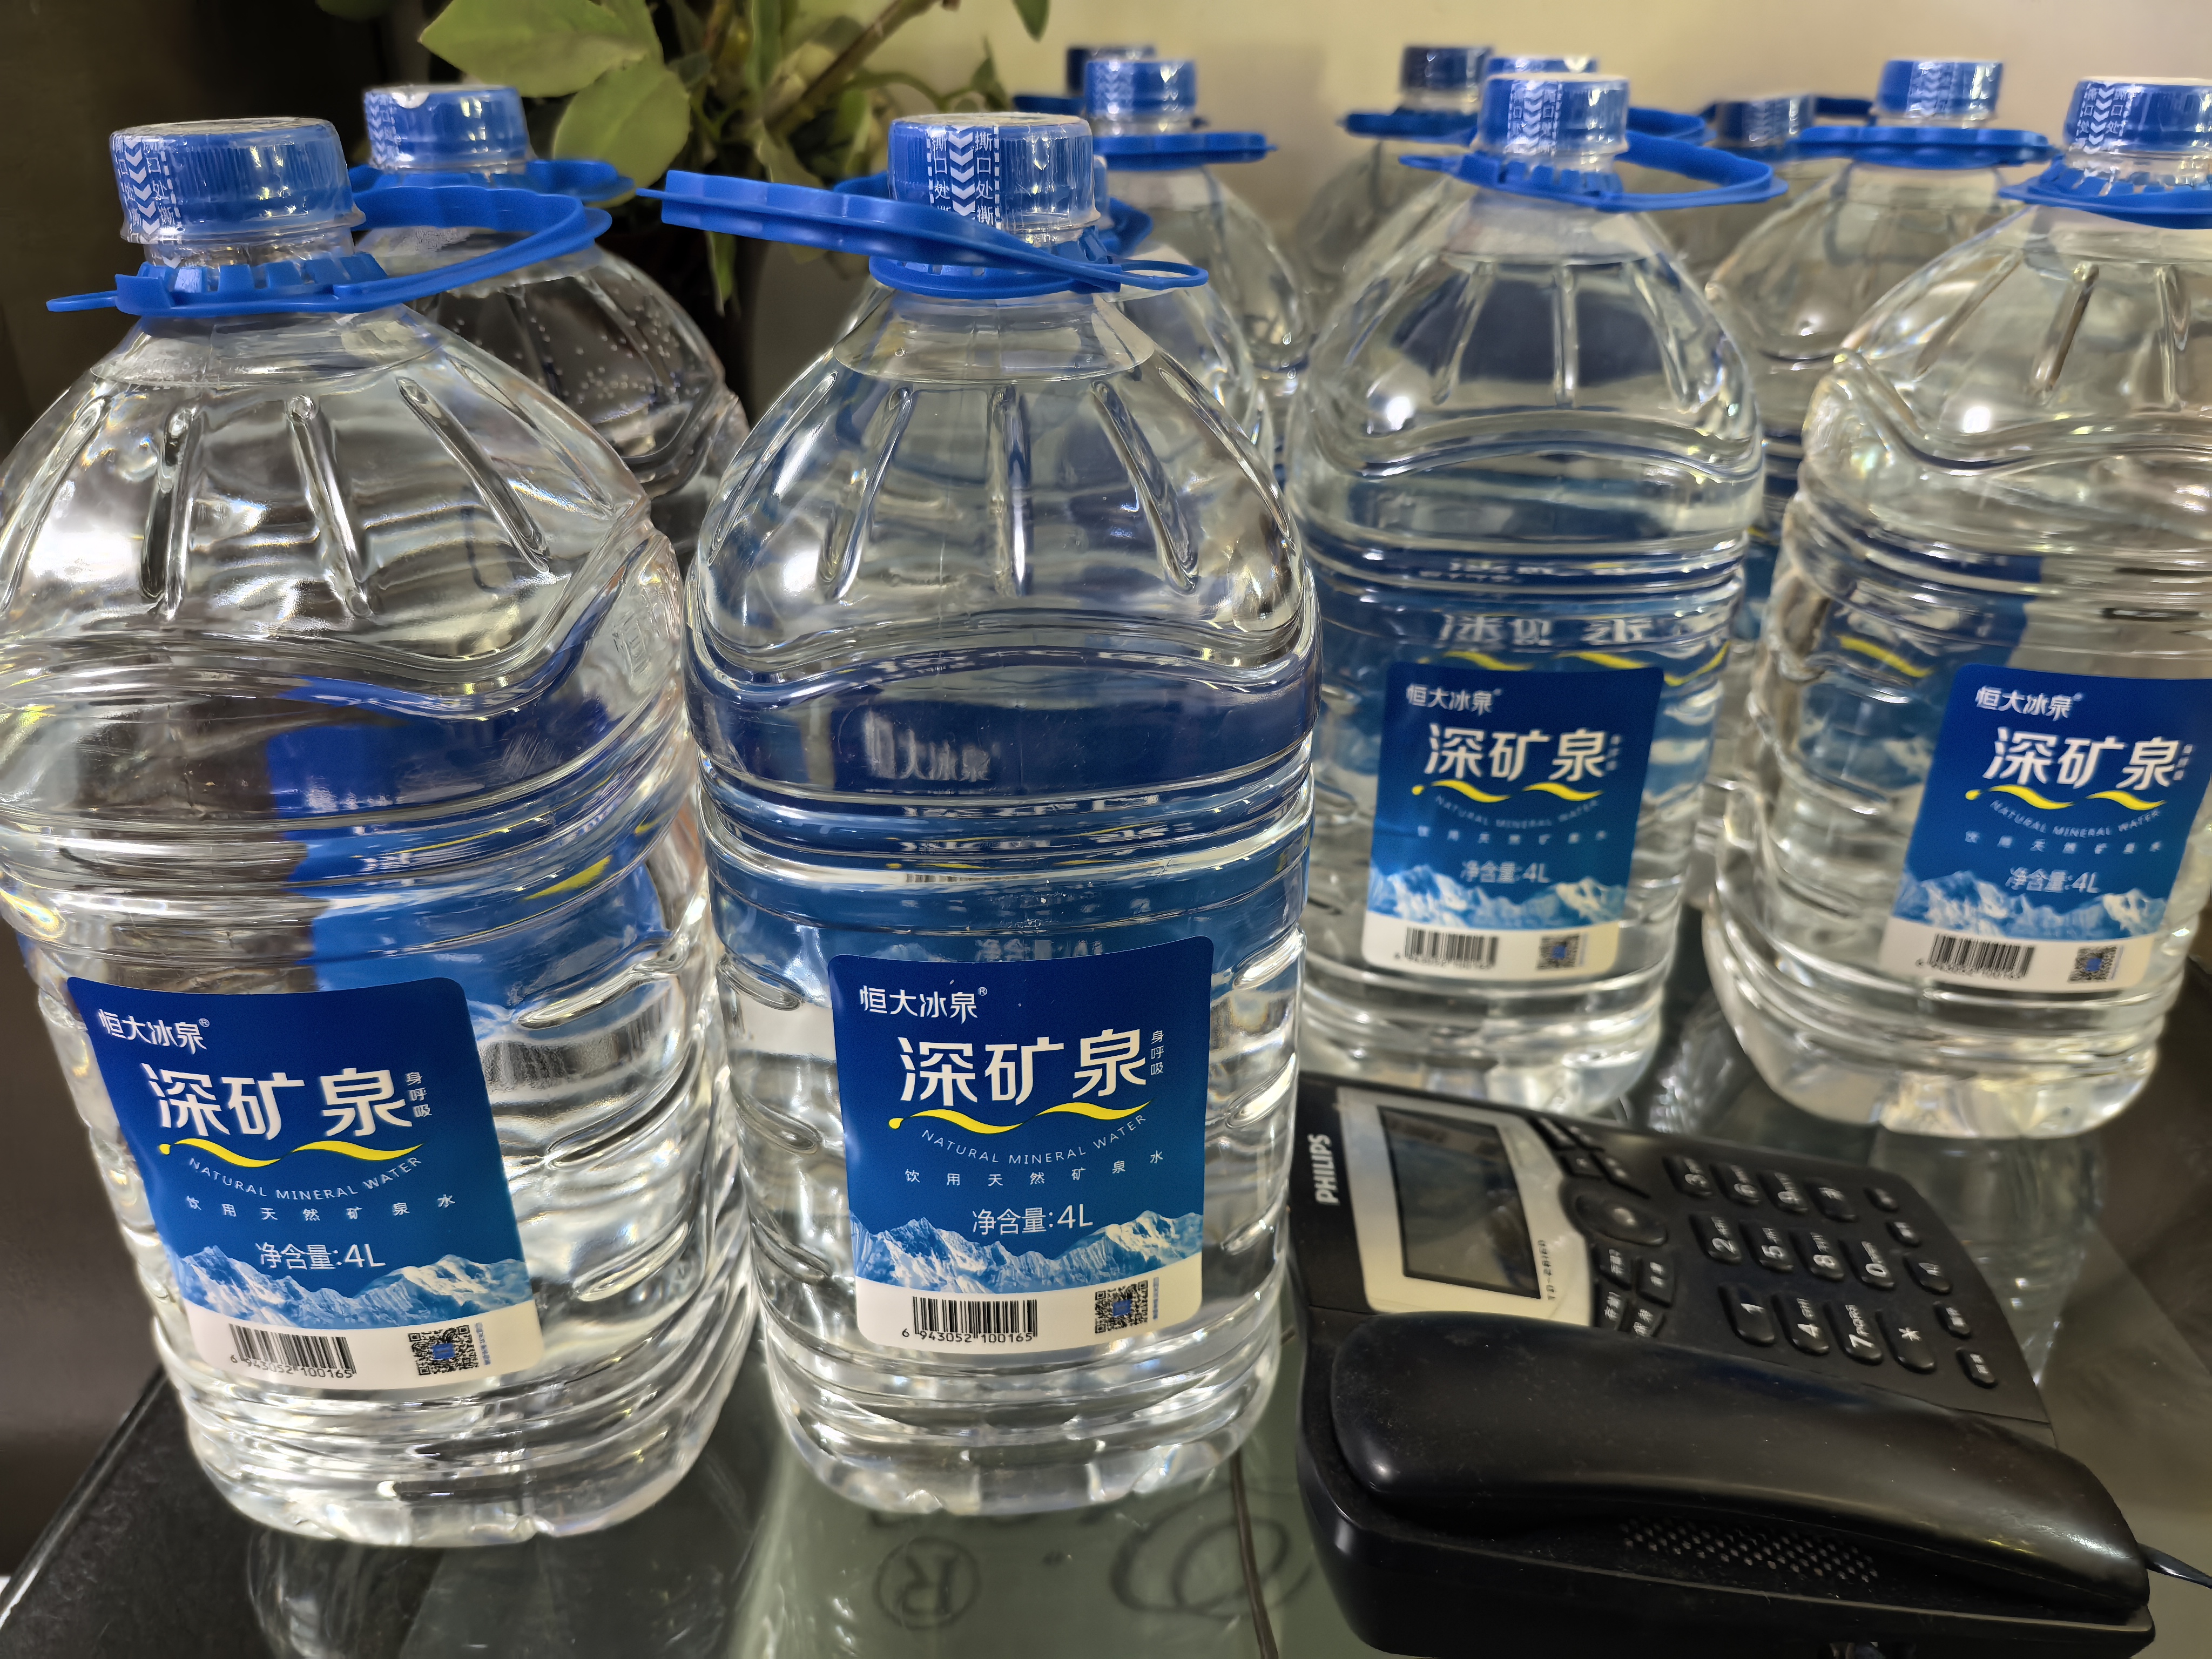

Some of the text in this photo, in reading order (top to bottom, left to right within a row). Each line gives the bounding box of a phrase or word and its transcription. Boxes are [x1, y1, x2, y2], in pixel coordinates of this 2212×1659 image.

[1424, 723, 1606, 783] 深矿泉
[1982, 727, 2182, 790] 深矿泉
[897, 1028, 1147, 1107] 深矿泉
[1150, 1030, 1164, 1075] 身呼吸
[141, 1063, 413, 1141] 深矿泉
[921, 1115, 1146, 1165] NATURAL MINERAL WATER
[188, 1157, 422, 1201] NATURAL MINERAL WATER
[1306, 1134, 1340, 1206] PHILIPS
[1712, 1238, 1736, 1255] 2
[1762, 1245, 1785, 1260] 5
[1813, 1254, 1837, 1269] 8
[1865, 1263, 1887, 1277] 0
[902, 1328, 1033, 1343] 6 943052 100165
[1797, 1324, 1820, 1339] 4
[1849, 1334, 1874, 1348] 7
[230, 1354, 353, 1379] 6 943052 100165
